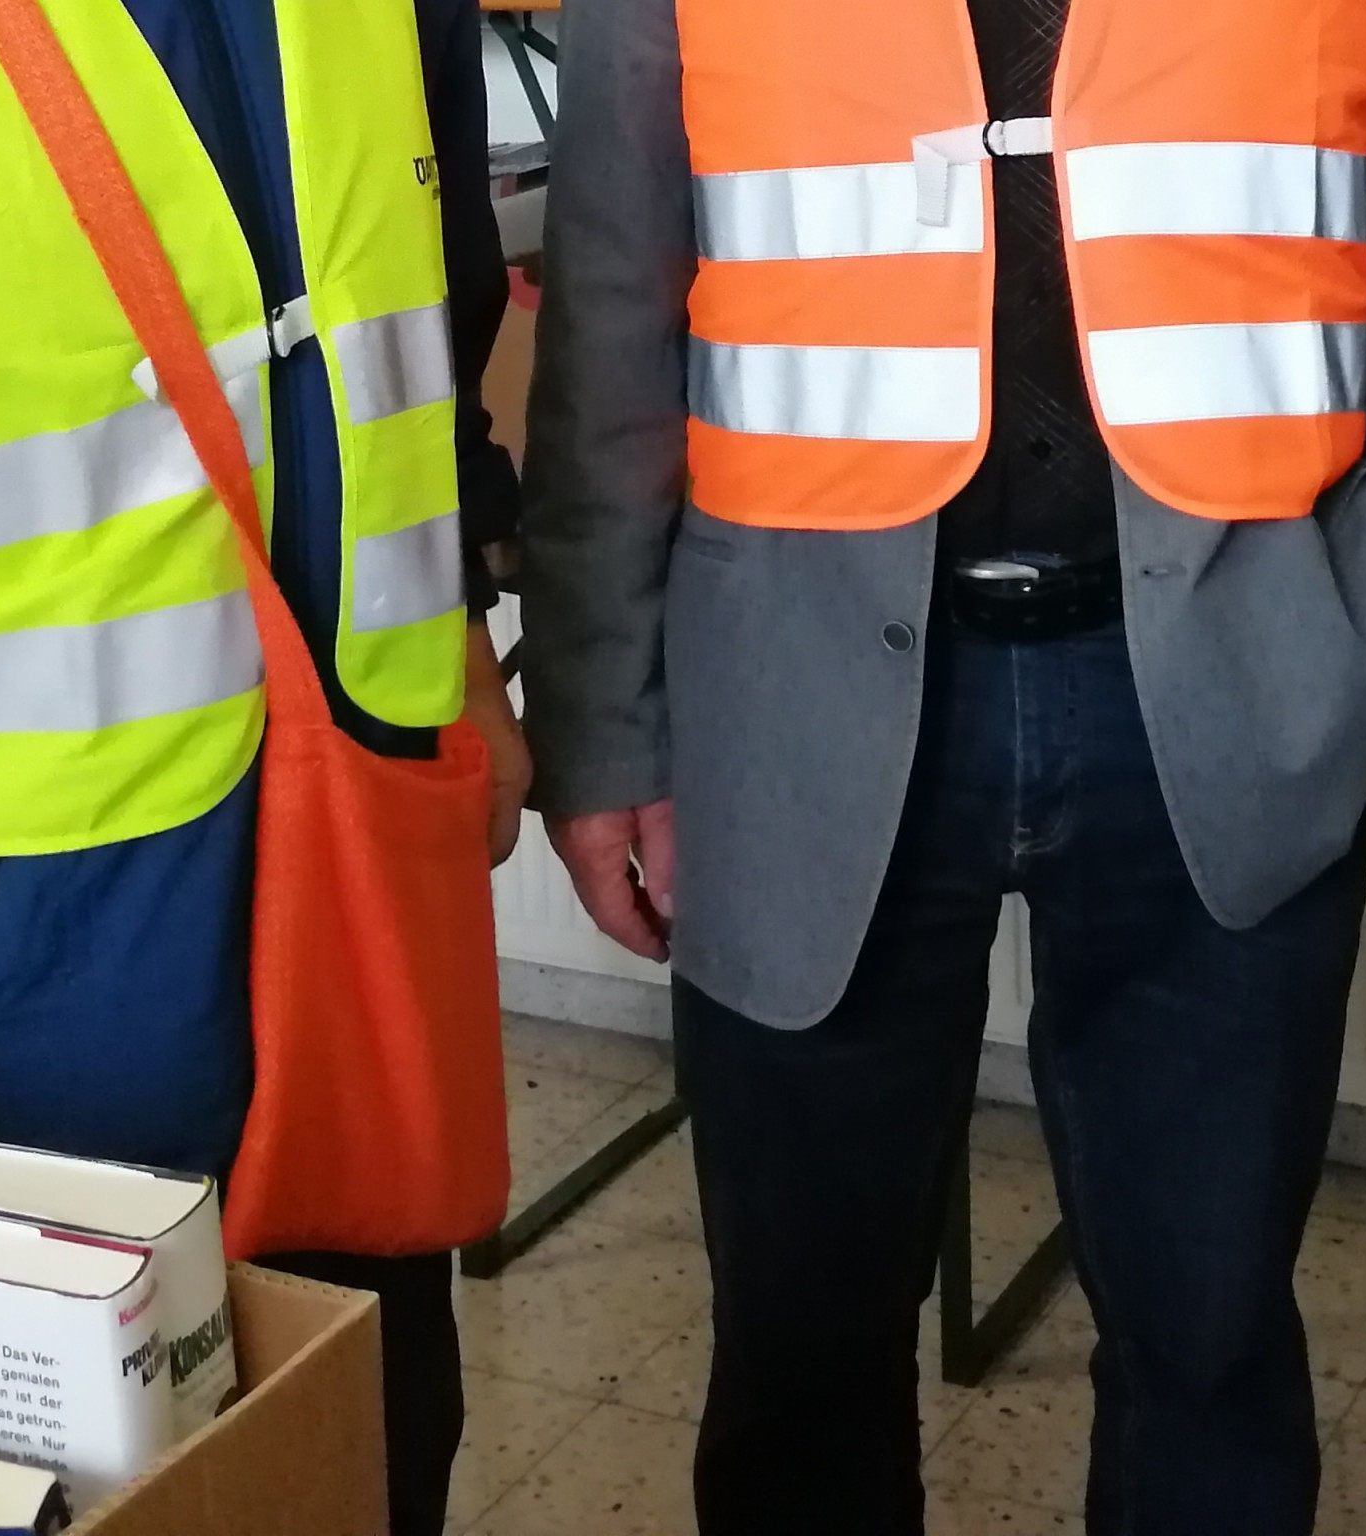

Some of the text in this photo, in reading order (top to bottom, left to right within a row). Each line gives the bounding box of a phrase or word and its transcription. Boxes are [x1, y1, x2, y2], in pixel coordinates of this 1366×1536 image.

[2, 1345, 29, 1362] Das
[32, 1350, 61, 1366] Ver-
[0, 1368, 61, 1389] genialen
[15, 1389, 32, 1404] ist
[39, 1394, 63, 1410] der
[16, 1412, 67, 1431] getrun-
[41, 1435, 67, 1452] Nur
